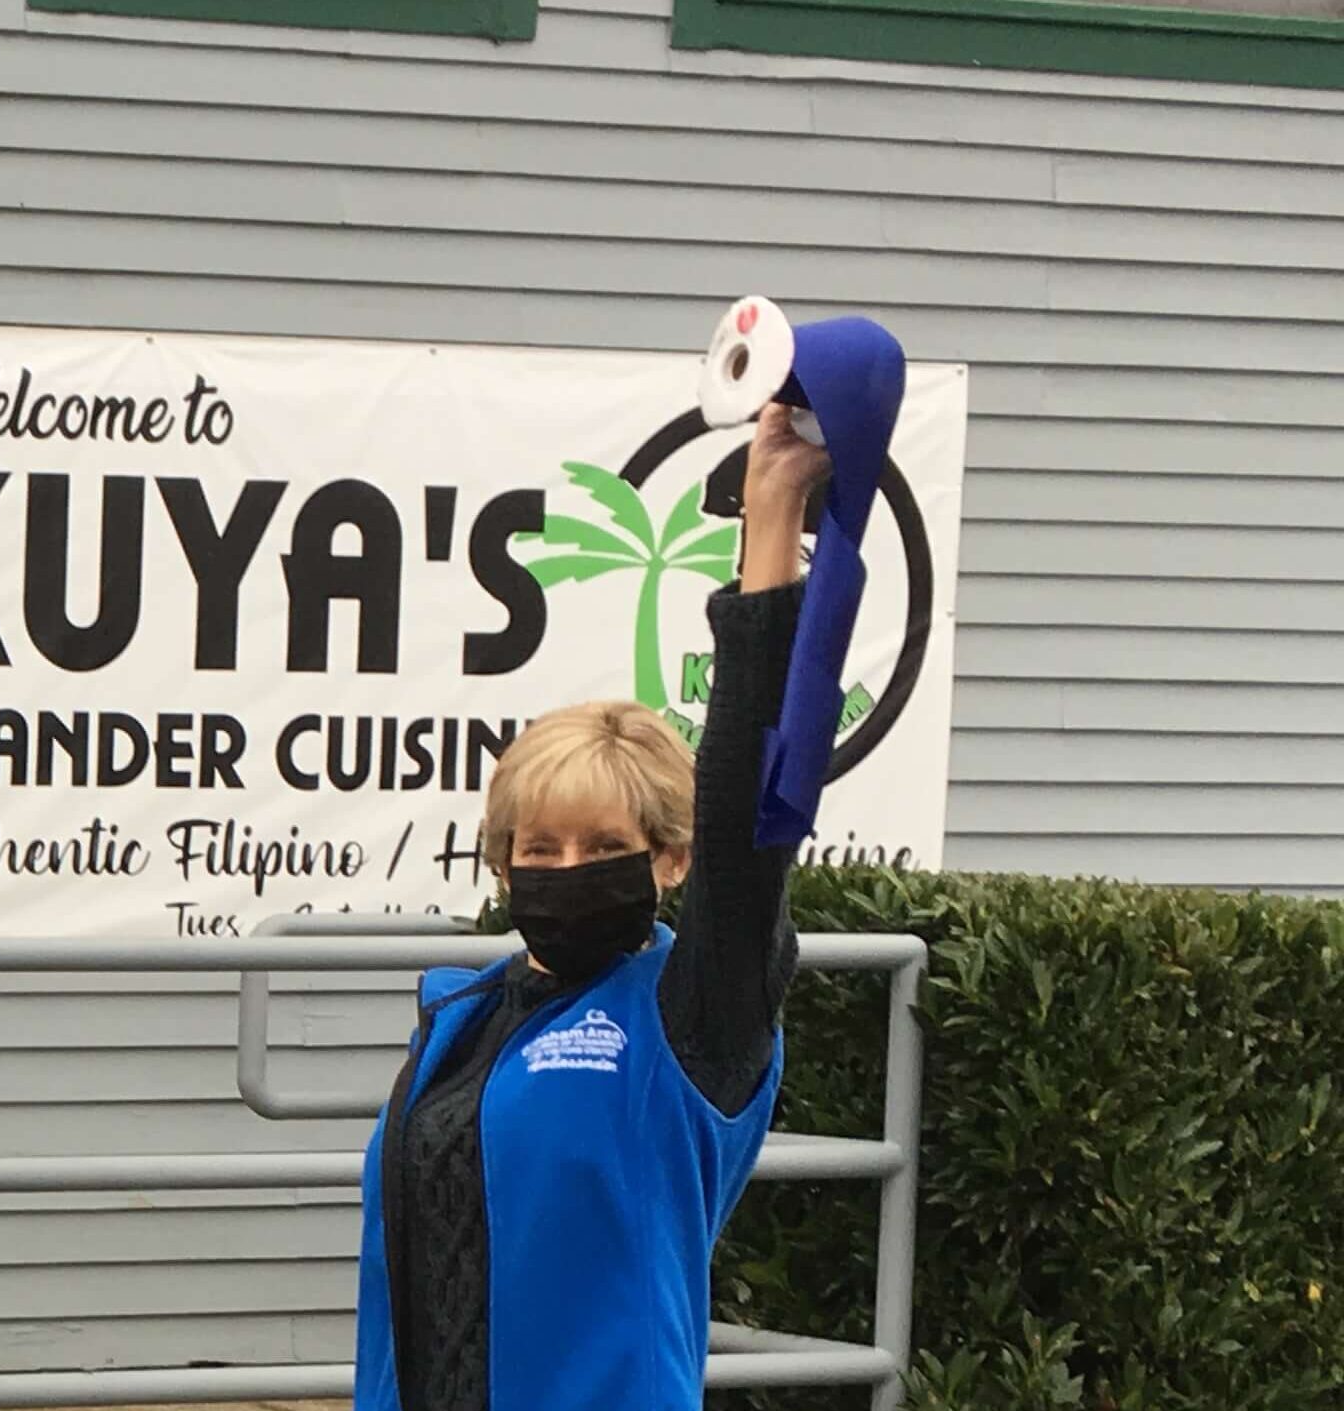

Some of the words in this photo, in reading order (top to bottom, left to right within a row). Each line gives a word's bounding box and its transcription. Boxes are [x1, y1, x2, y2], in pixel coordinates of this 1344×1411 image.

[182, 374, 234, 446] to
[275, 713, 534, 792] CUISIN
[165, 817, 370, 898] Filipino
[164, 901, 242, 937] Tues
